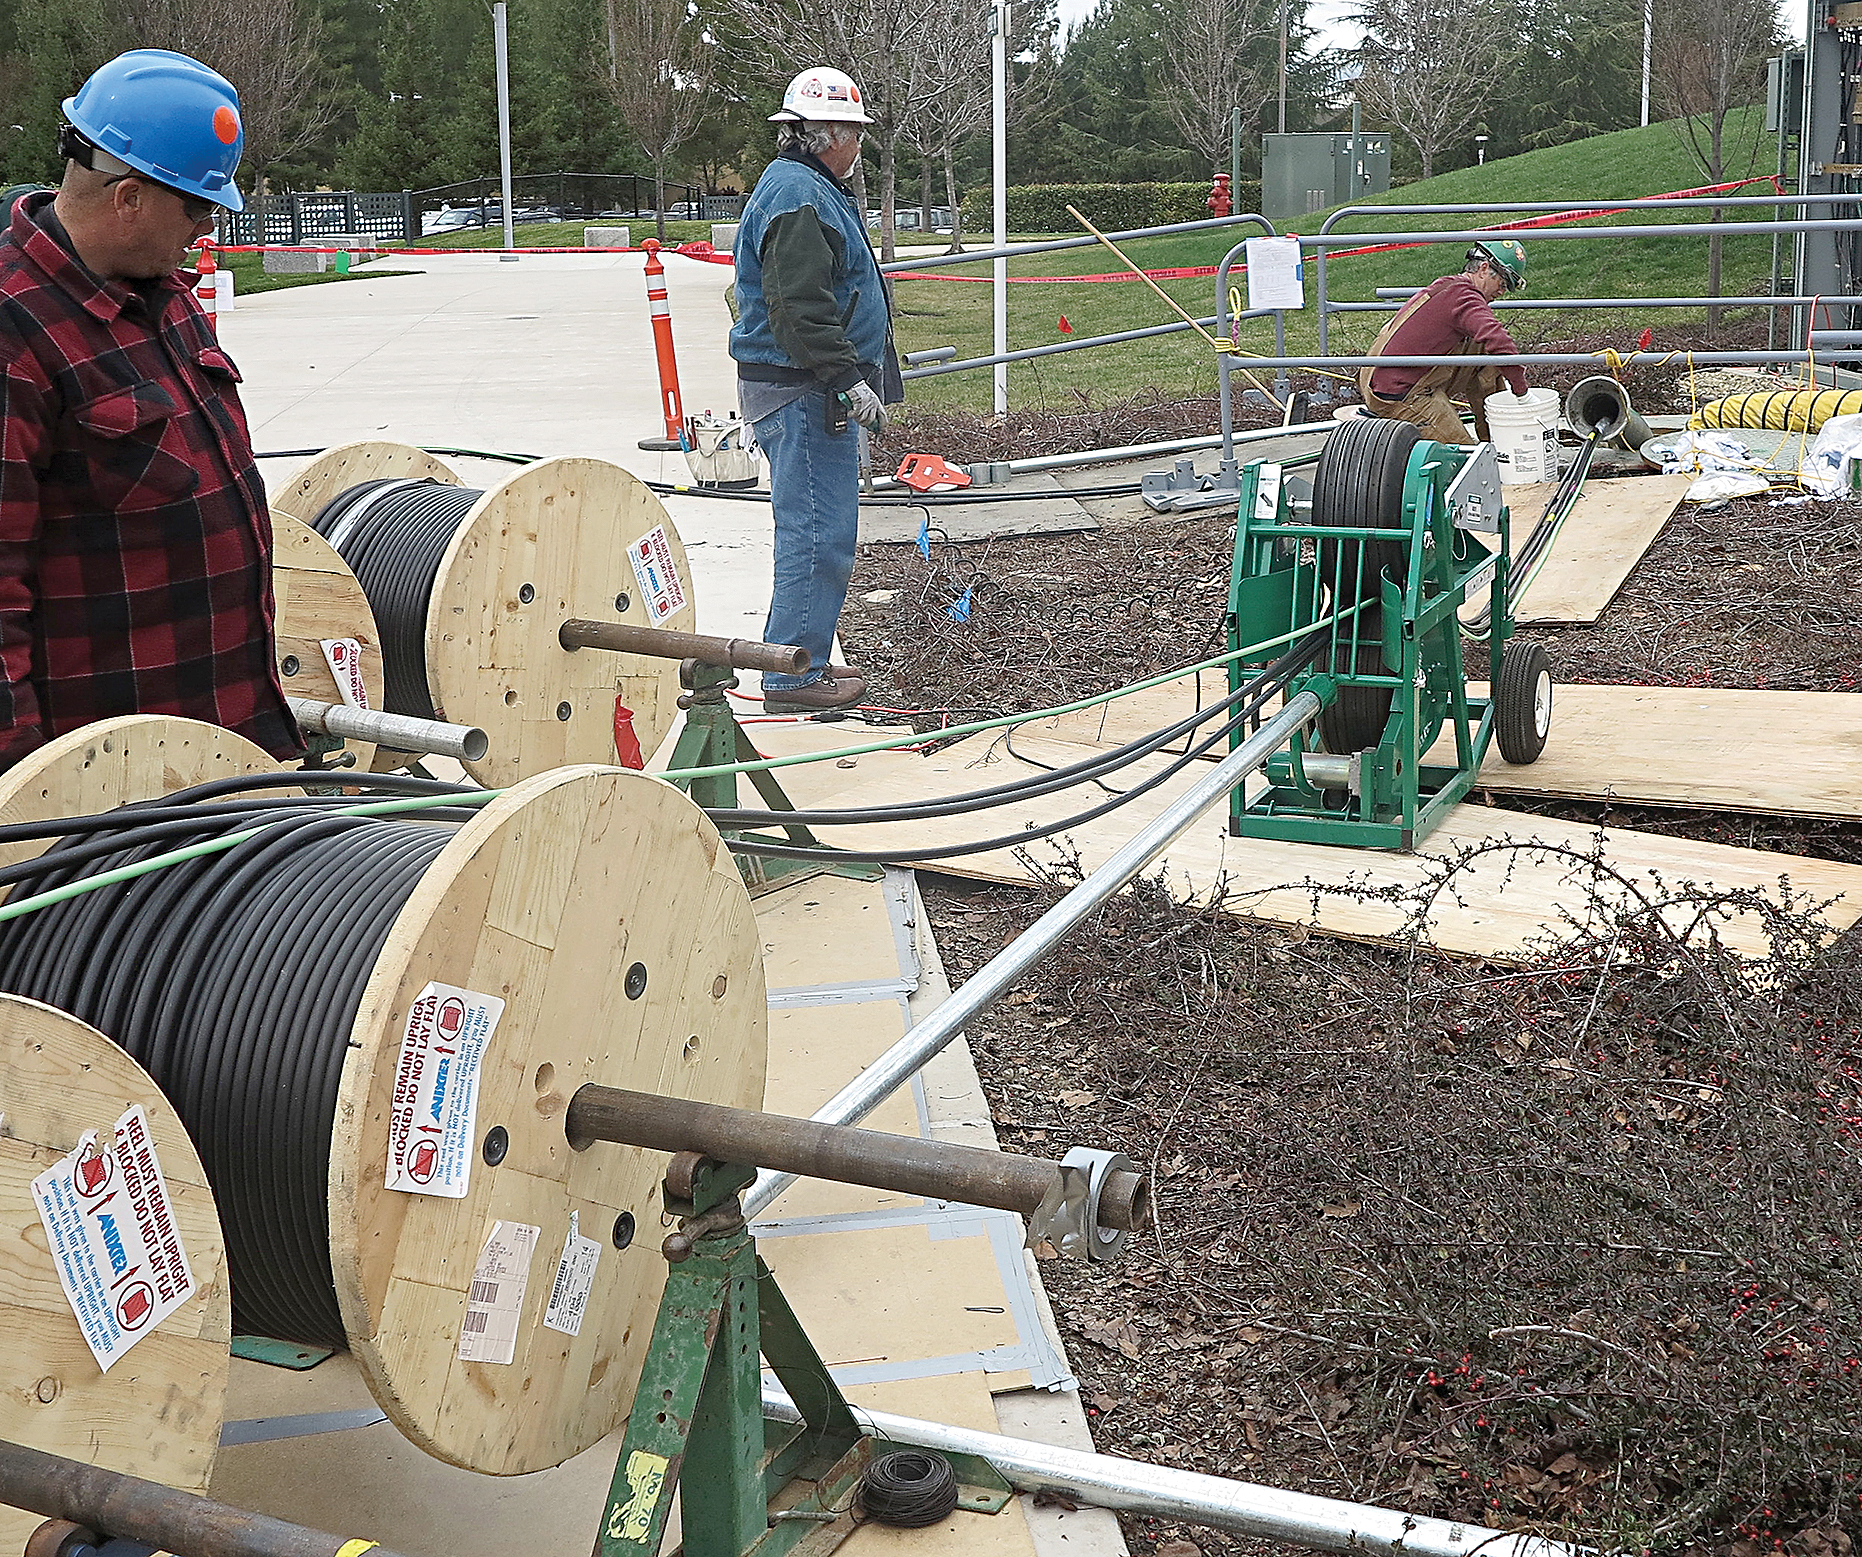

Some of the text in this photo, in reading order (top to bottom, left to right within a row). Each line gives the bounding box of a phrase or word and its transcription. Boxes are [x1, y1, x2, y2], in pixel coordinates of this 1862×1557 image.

[473, 1006, 486, 1027] MUST
[417, 1025, 431, 1050] LAY
[470, 1027, 479, 1043] you
[394, 1050, 414, 1104] REMAIN
[405, 998, 426, 1048] UPRIG
[460, 1043, 475, 1078] UPRIGHT,
[411, 1051, 426, 1081] NOT
[405, 1083, 419, 1104] DO
[430, 1058, 450, 1123] ANIXTER
[436, 1164, 445, 1178] This
[454, 1062, 462, 1085] carrier
[461, 1007, 476, 1041] UPRIGHT
[454, 1078, 466, 1112] delivered
[461, 1078, 473, 1117] Documents
[450, 1113, 460, 1130] NOT
[457, 1118, 469, 1149] Delivery
[394, 1107, 414, 1166] BLOCKED
[457, 1150, 464, 1160] on
[115, 1140, 142, 1199] BLOCKED
[444, 1155, 454, 1186] position.
[455, 1161, 463, 1178] note
[47, 1178, 64, 1211] position.
[62, 1175, 73, 1193] This
[42, 1195, 53, 1213] note
[71, 1207, 81, 1225] was
[126, 1115, 190, 1294] REEL MUST REMAIN UPRIGHT
[132, 1197, 149, 1222] DO
[48, 1212, 56, 1224] on
[51, 1221, 66, 1255] Delivery
[66, 1230, 79, 1250] NOT
[74, 1224, 88, 1246] given
[97, 1214, 128, 1276] ANIXTER
[139, 1218, 159, 1250] NOT
[83, 1243, 90, 1254] to
[86, 1253, 95, 1267] the
[148, 1247, 166, 1274] LAY
[61, 1252, 78, 1293] Documents
[72, 1249, 90, 1283] delivered
[83, 1280, 100, 1318] UPRIGHT,
[97, 1288, 105, 1299] in
[155, 1272, 175, 1304] FLAT
[100, 1298, 108, 1309] an
[92, 1317, 105, 1333] you
[103, 1306, 121, 1341] UPRIGHT
[100, 1330, 114, 1354] MUST
[638, 1507, 652, 1529] 70
